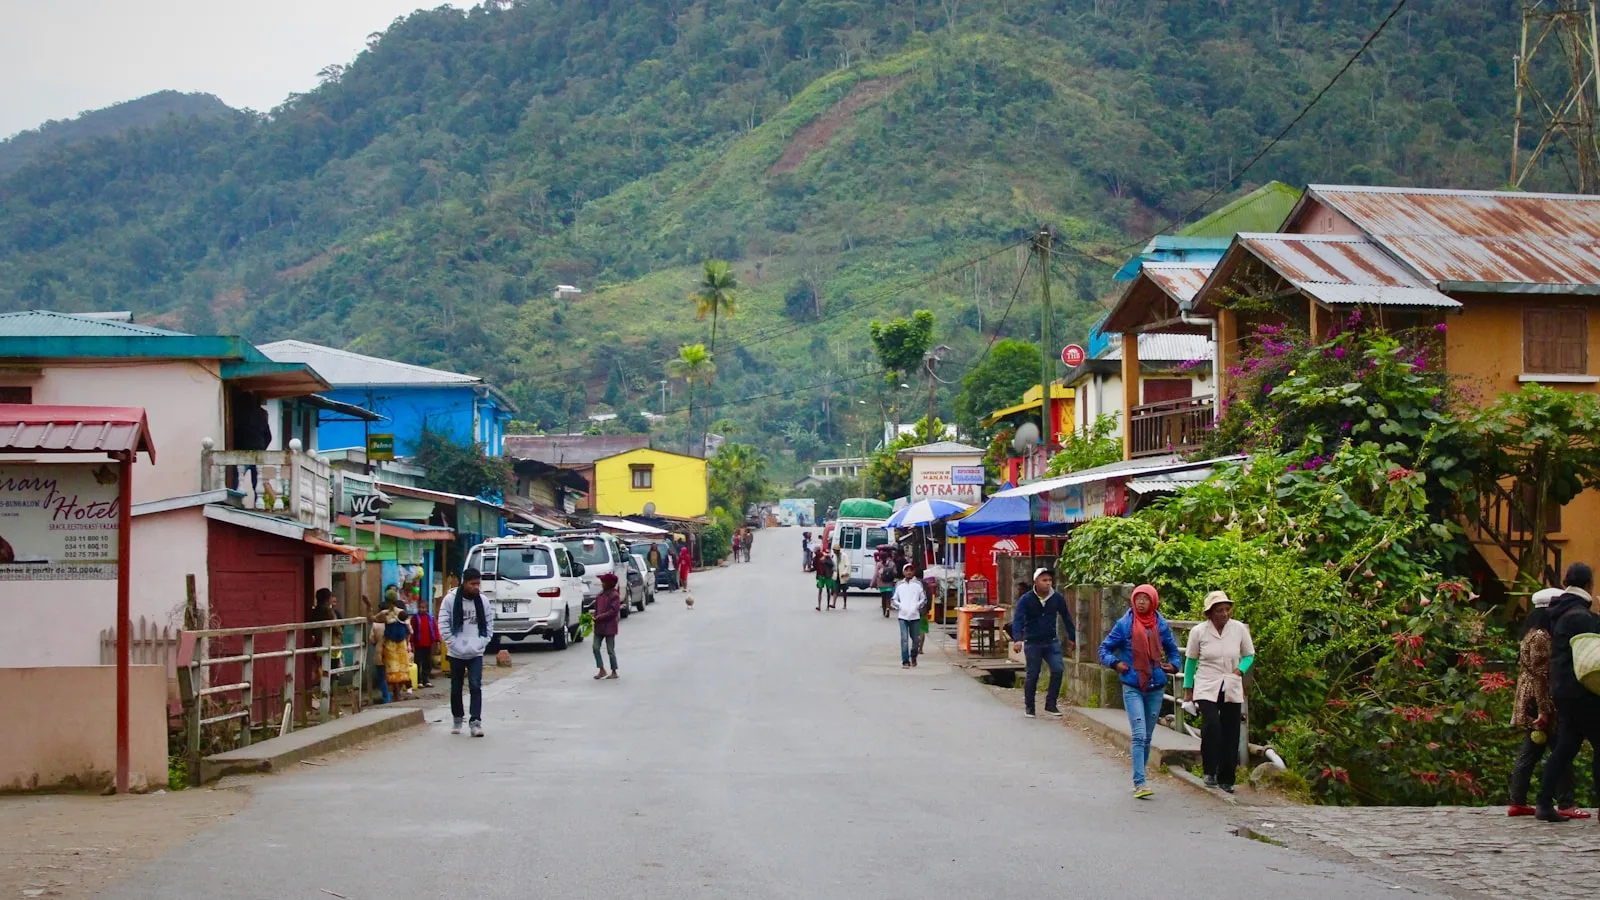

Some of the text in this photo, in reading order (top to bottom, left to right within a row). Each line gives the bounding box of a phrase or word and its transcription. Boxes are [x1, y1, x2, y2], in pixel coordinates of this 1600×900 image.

[0, 471, 60, 509] rary
[52, 495, 119, 521] Hotel
[351, 495, 380, 513] WC
